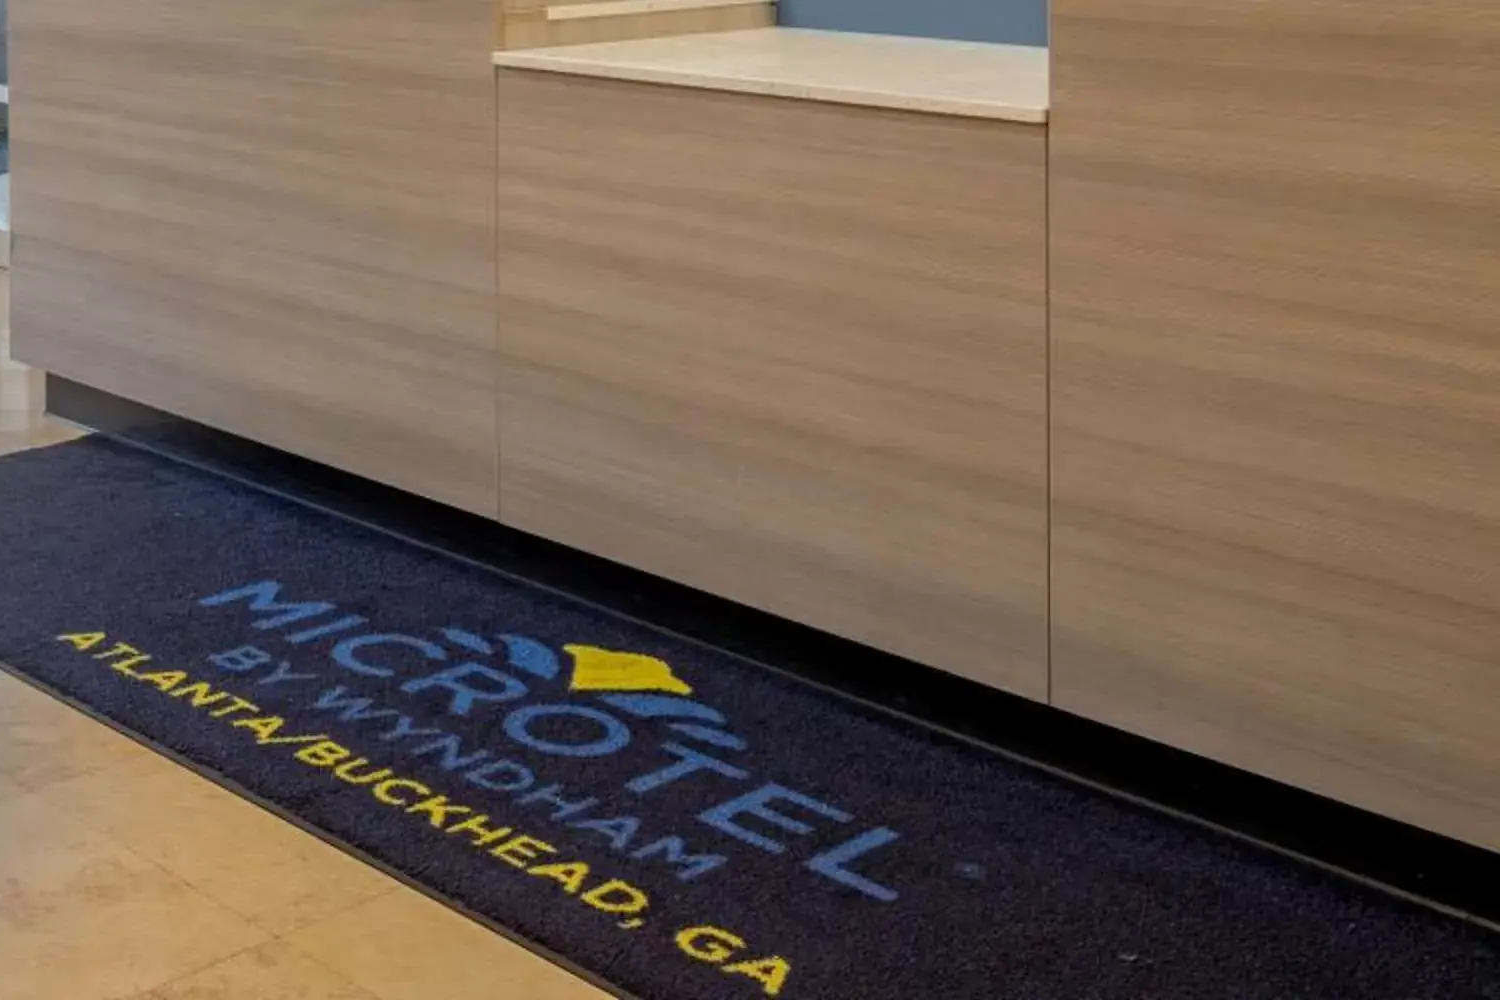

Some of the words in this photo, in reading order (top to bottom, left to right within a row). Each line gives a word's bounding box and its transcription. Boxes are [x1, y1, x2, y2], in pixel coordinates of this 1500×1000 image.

[57, 630, 652, 930] ATLANTA/BUCKHEAD,
[675, 925, 793, 996] GA
[201, 580, 899, 902] MICROTEL
[208, 644, 313, 688] BY
[312, 685, 727, 882] WYNDHAM
